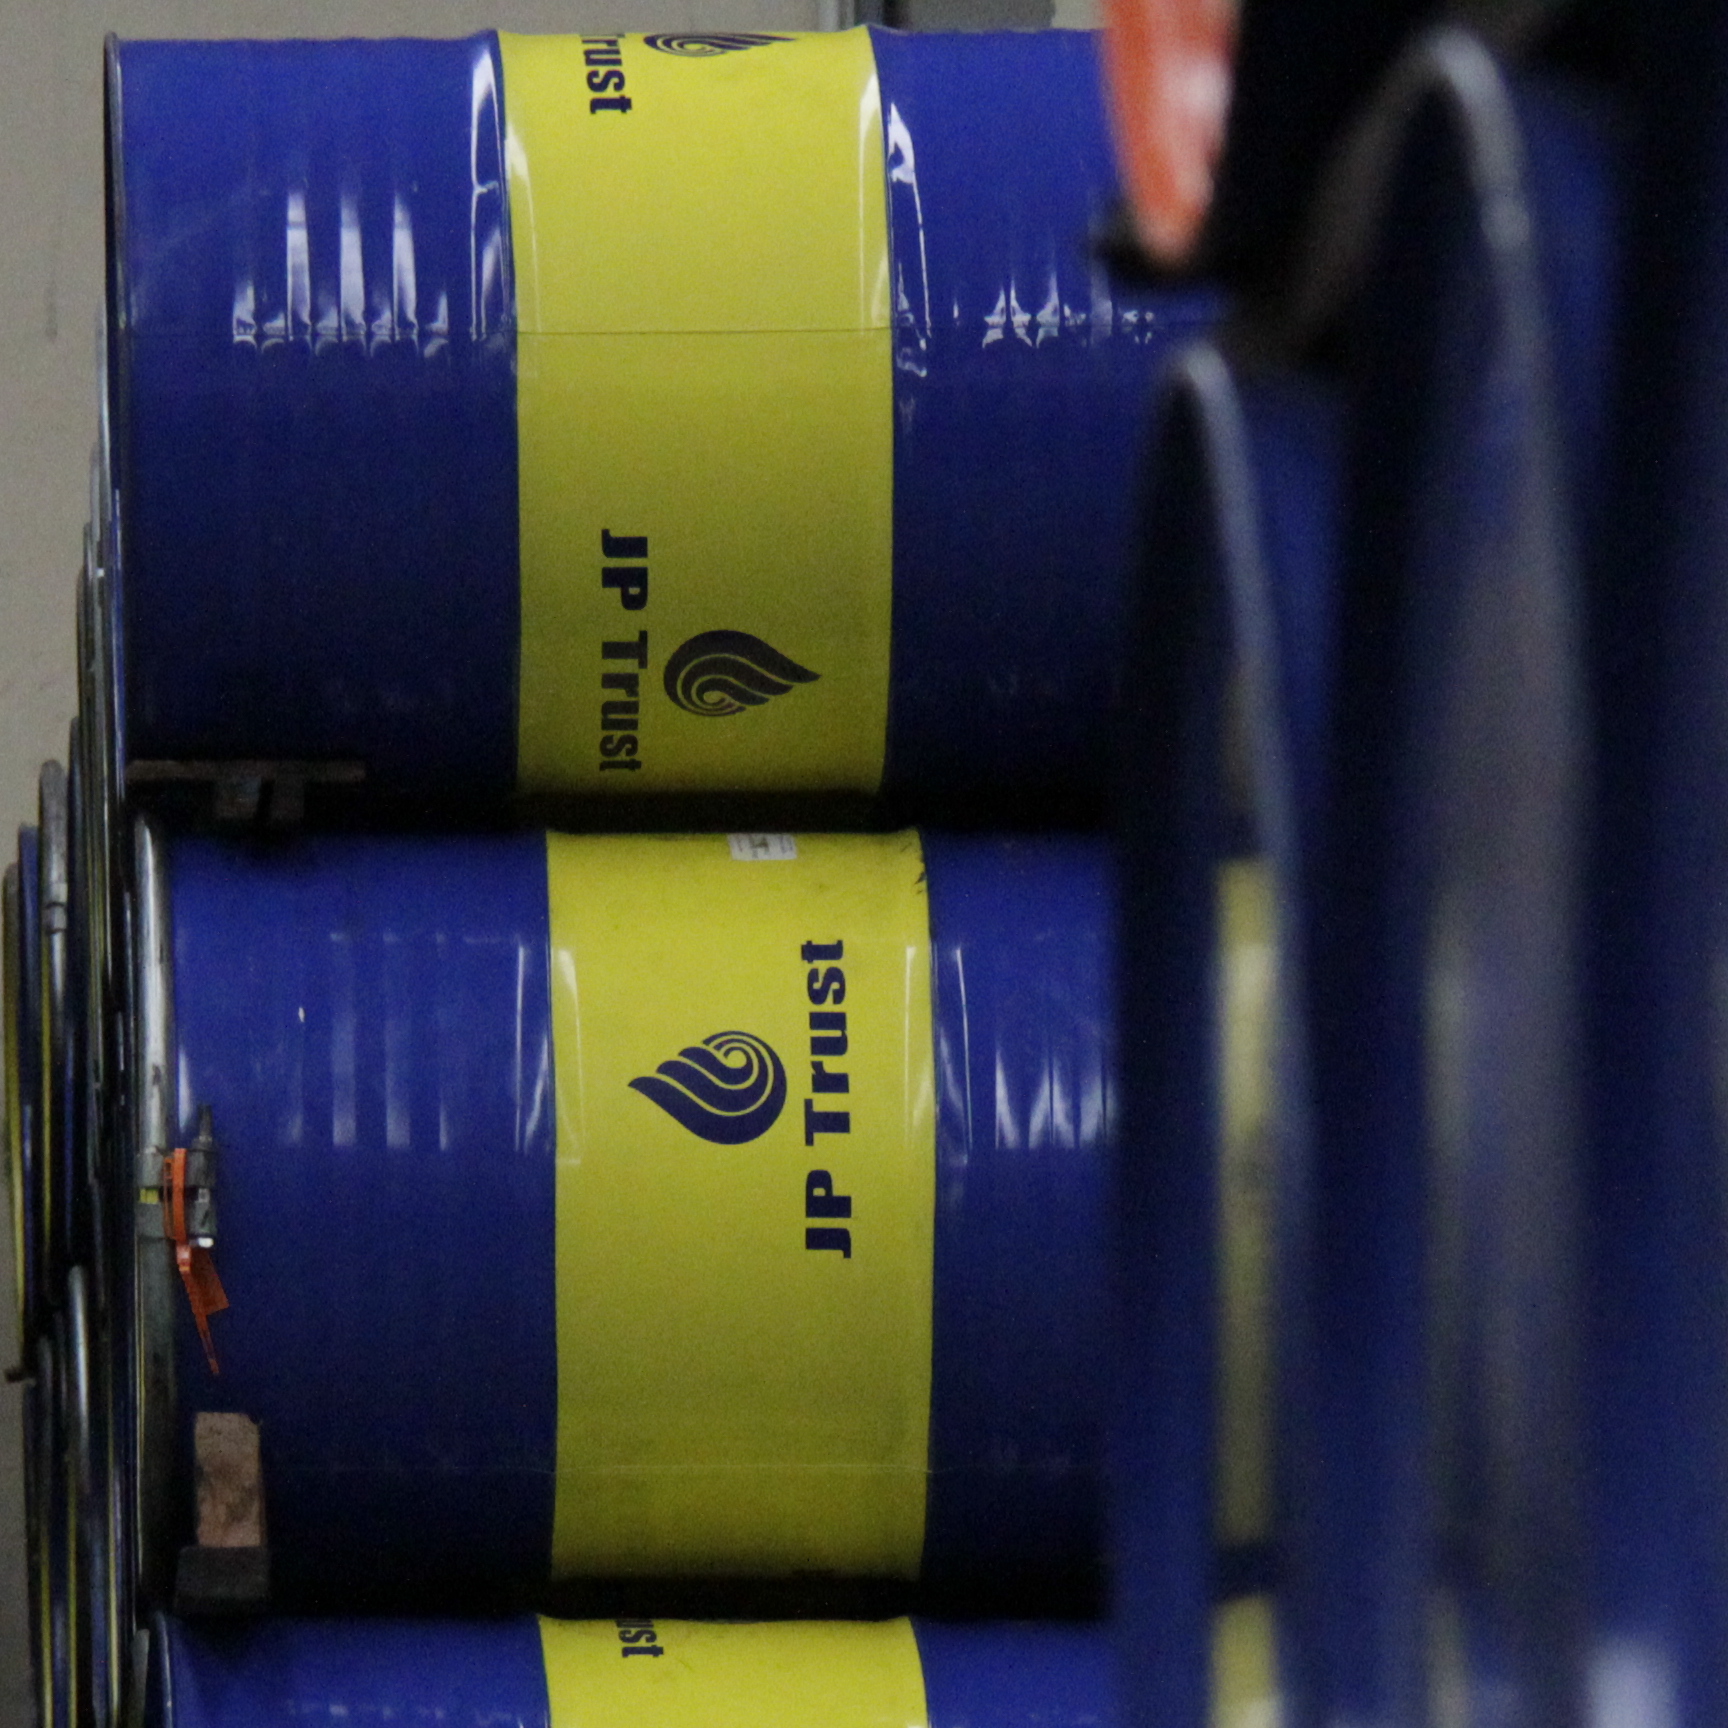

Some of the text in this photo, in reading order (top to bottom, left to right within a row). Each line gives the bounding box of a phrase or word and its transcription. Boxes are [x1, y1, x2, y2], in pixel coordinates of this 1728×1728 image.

[580, 34, 632, 114] rust
[599, 528, 648, 772] JP Trust
[801, 939, 852, 1259] JP Trust
